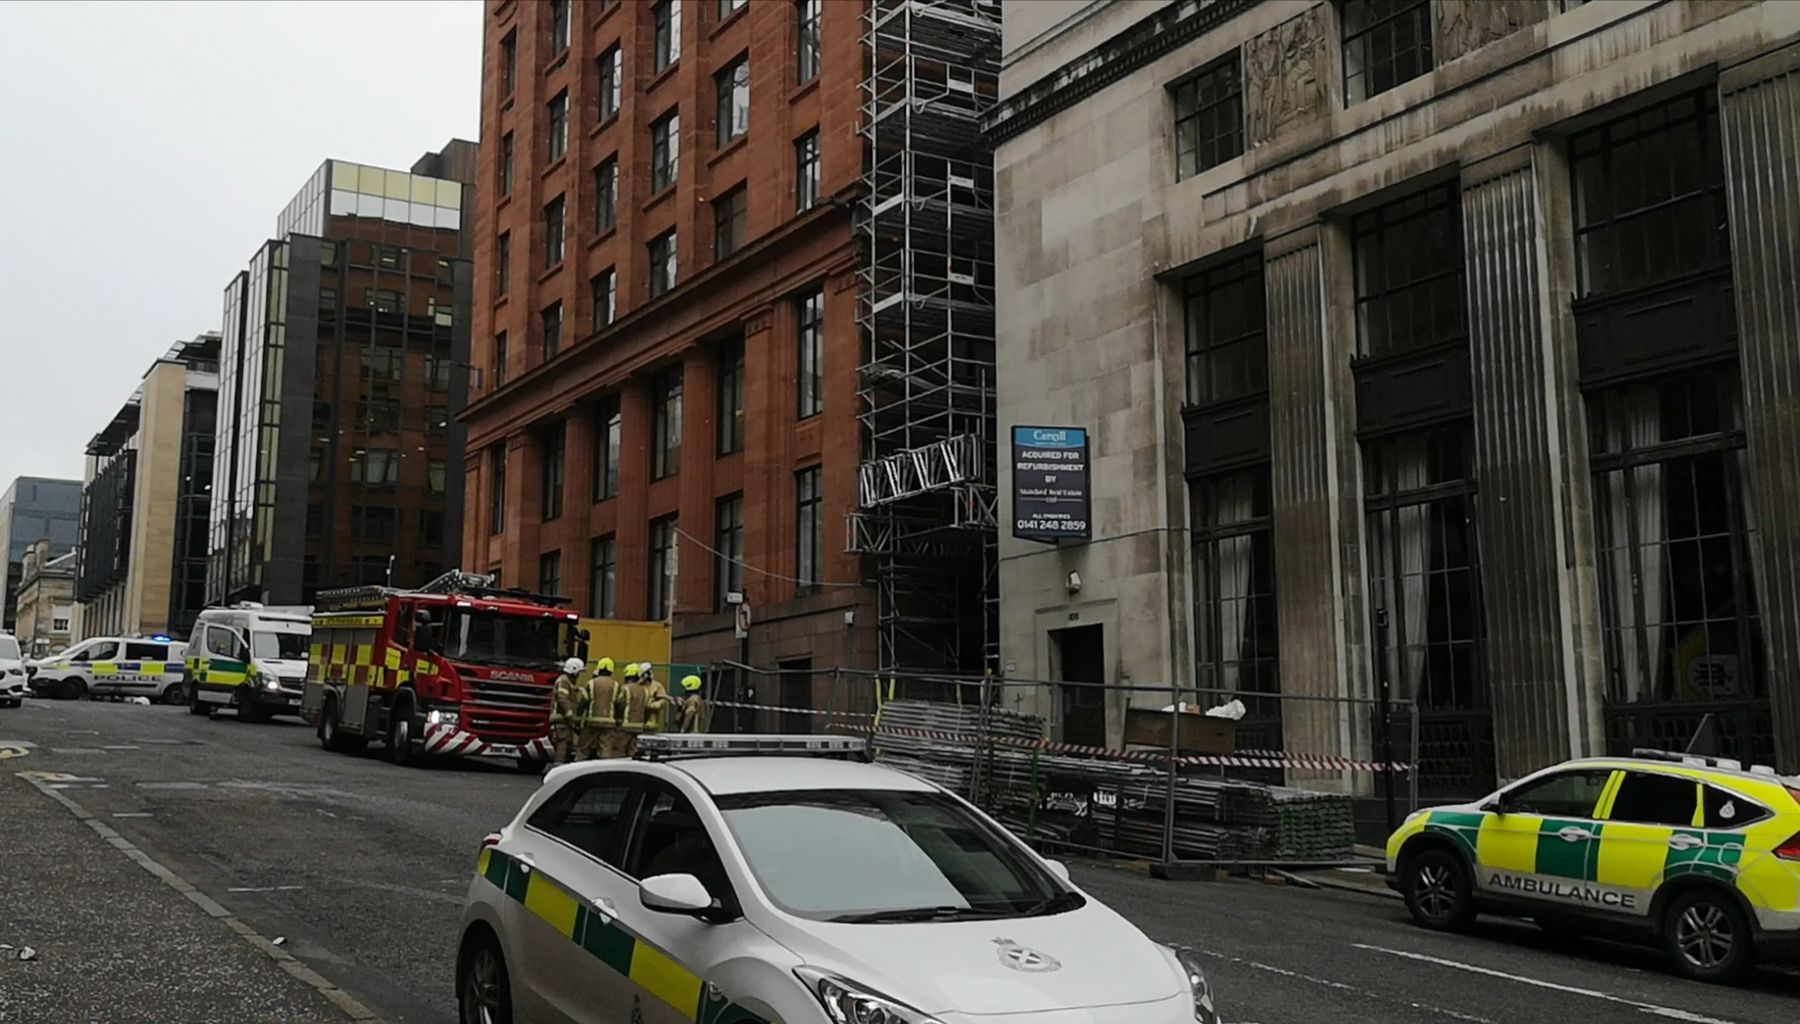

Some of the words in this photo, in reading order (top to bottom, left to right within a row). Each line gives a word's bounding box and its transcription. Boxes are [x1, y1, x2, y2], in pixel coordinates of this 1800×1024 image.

[1022, 451, 1061, 459] ACQUIRED
[1017, 462, 1084, 471] REFURBISHMENT
[1045, 475, 1056, 483] BY
[1017, 520, 1038, 529] 0141
[1039, 520, 1058, 530] 248
[1060, 520, 1086, 530] 2859
[490, 670, 535, 682] SCANIA
[1489, 873, 1636, 908] AMBULANCE
